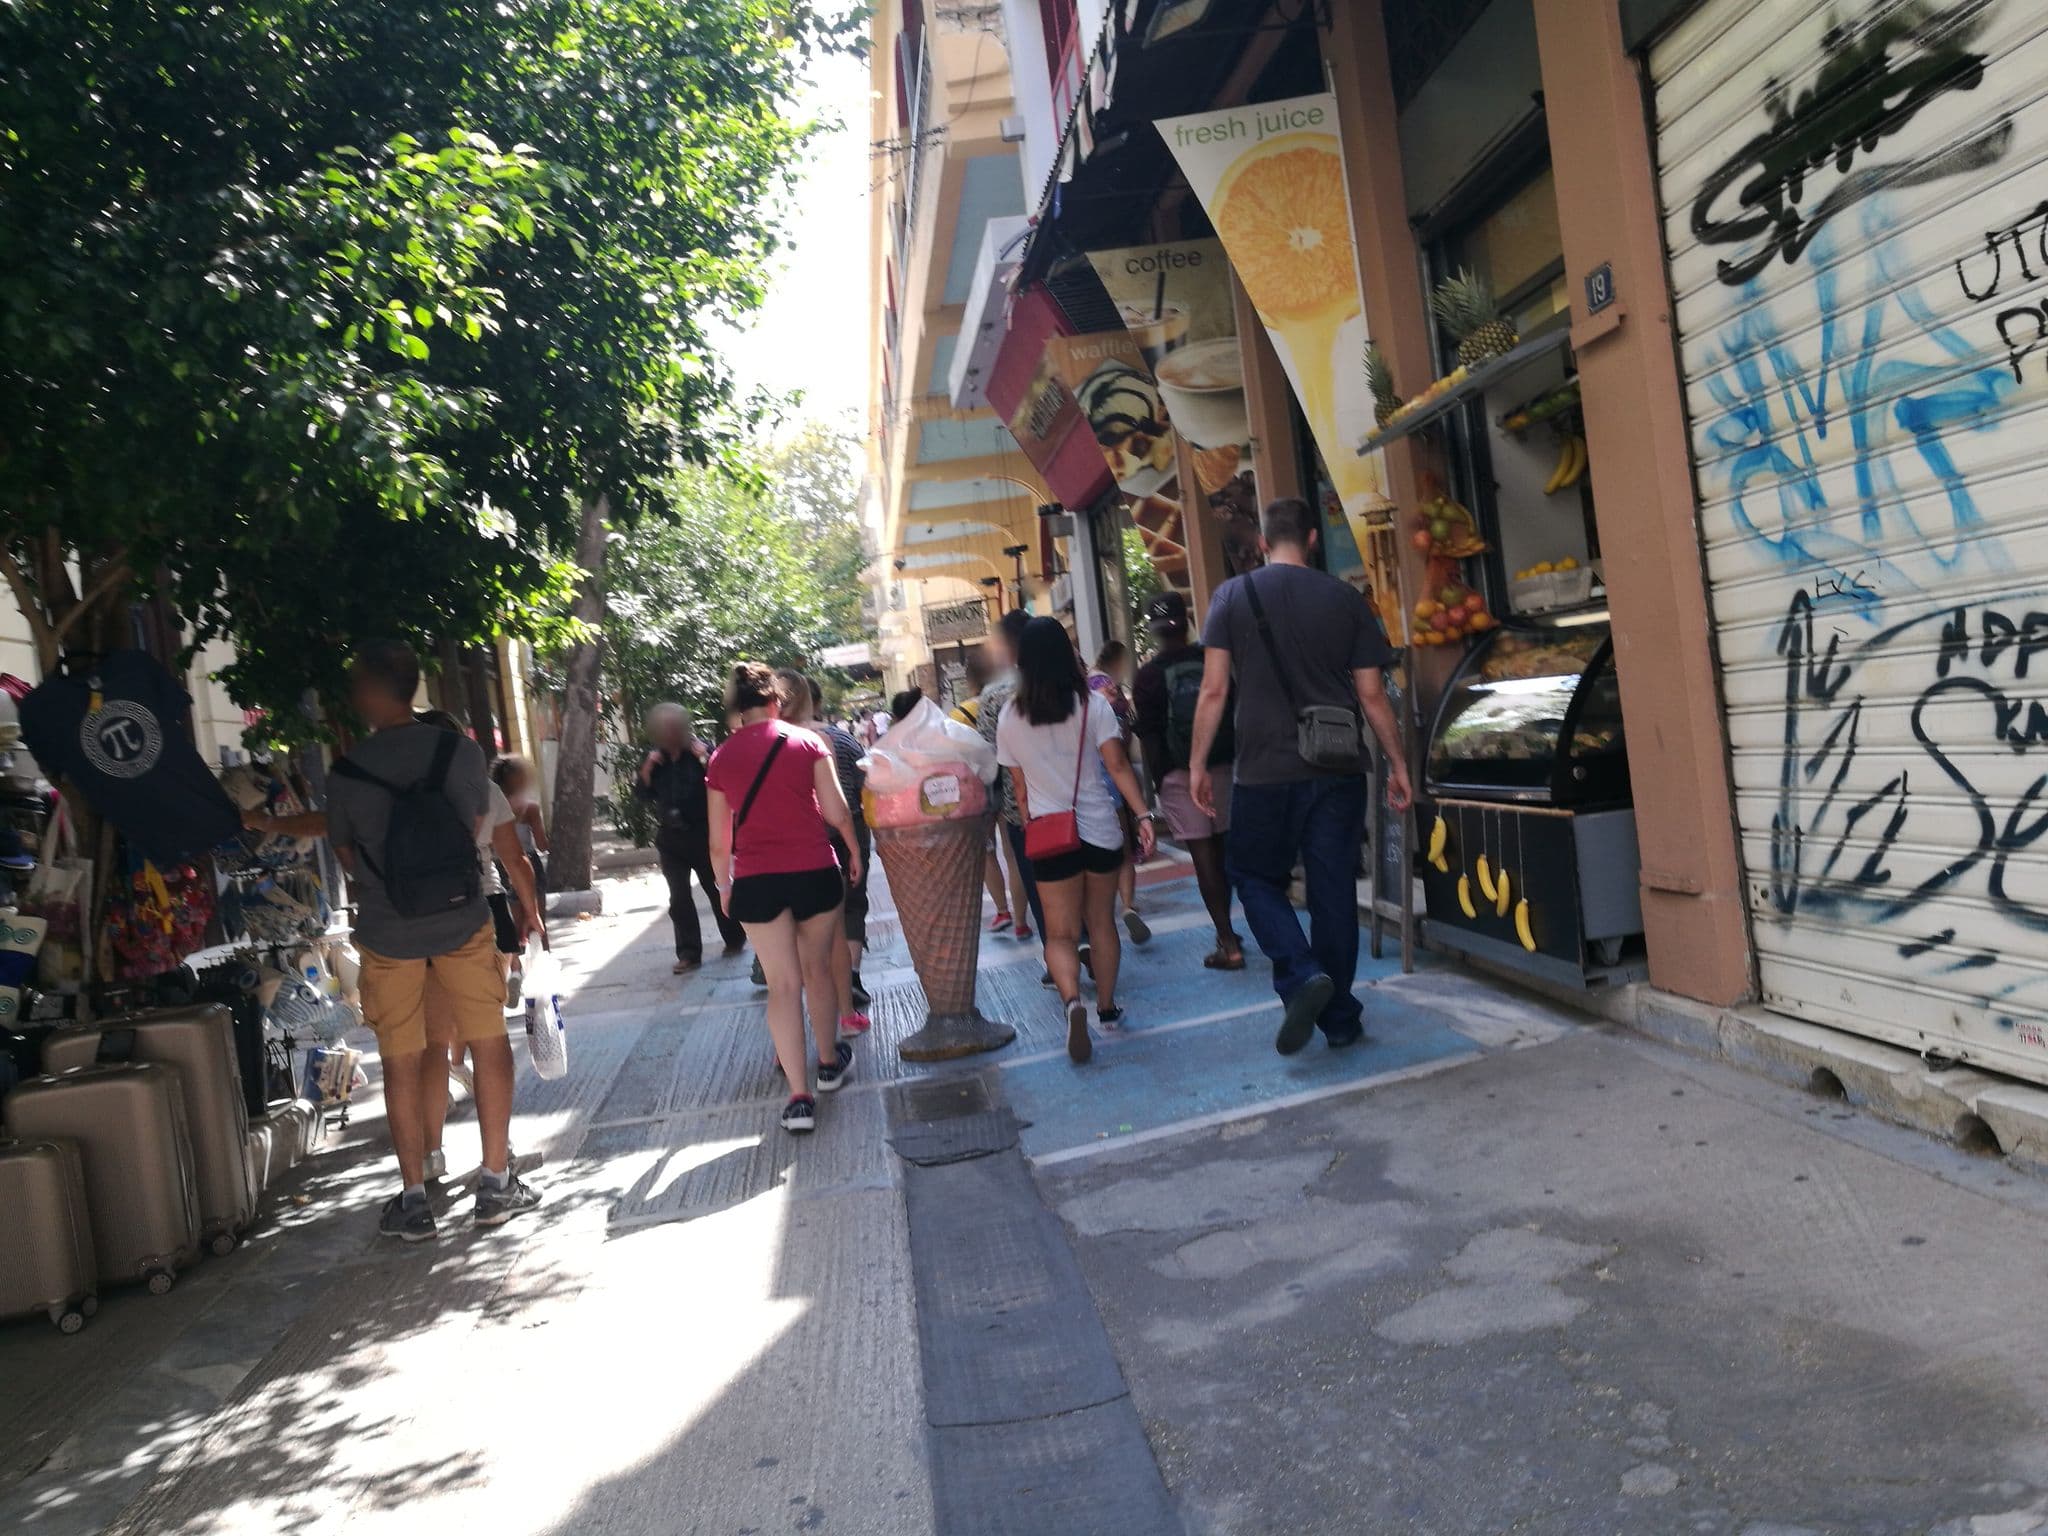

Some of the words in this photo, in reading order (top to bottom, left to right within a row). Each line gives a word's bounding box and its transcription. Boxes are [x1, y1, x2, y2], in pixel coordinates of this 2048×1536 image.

[1175, 116, 1246, 147] fresh
[1256, 107, 1324, 141] juice
[1125, 250, 1202, 275] coffee
[1591, 273, 1606, 305] 19
